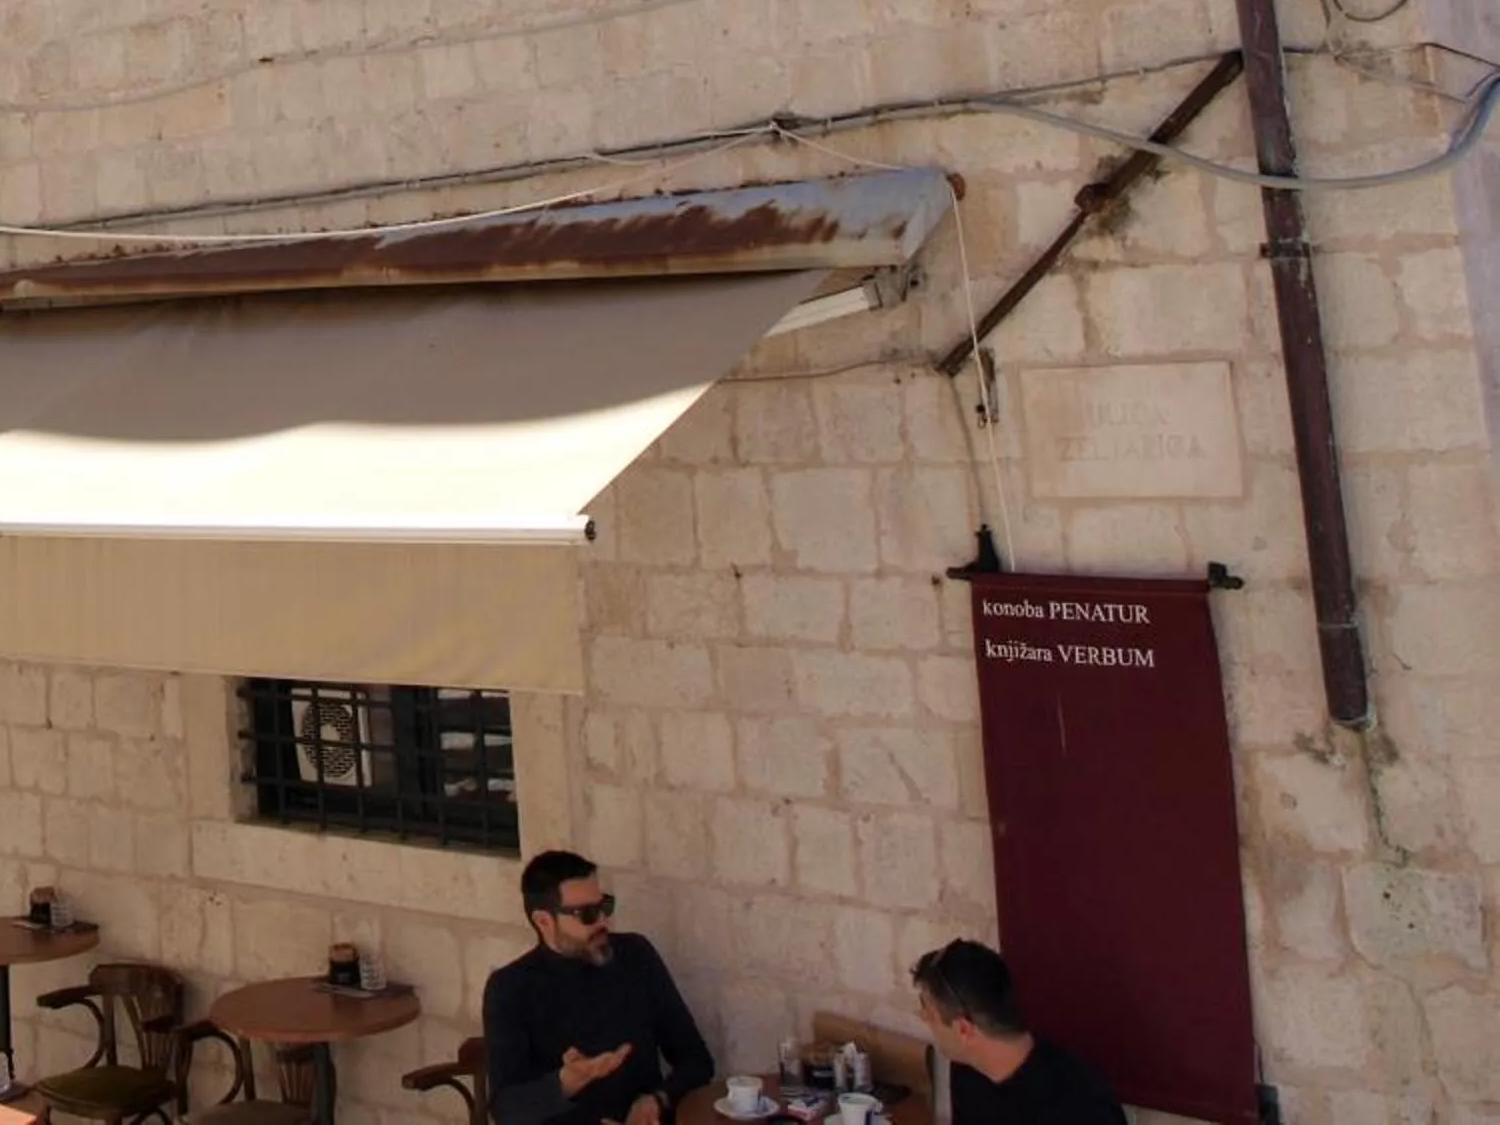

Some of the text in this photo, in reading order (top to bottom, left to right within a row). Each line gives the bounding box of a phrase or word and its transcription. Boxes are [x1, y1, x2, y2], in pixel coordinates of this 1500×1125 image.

[982, 599, 1150, 624] konoba PENATUR
[985, 639, 1155, 668] knjižara VERBUM
